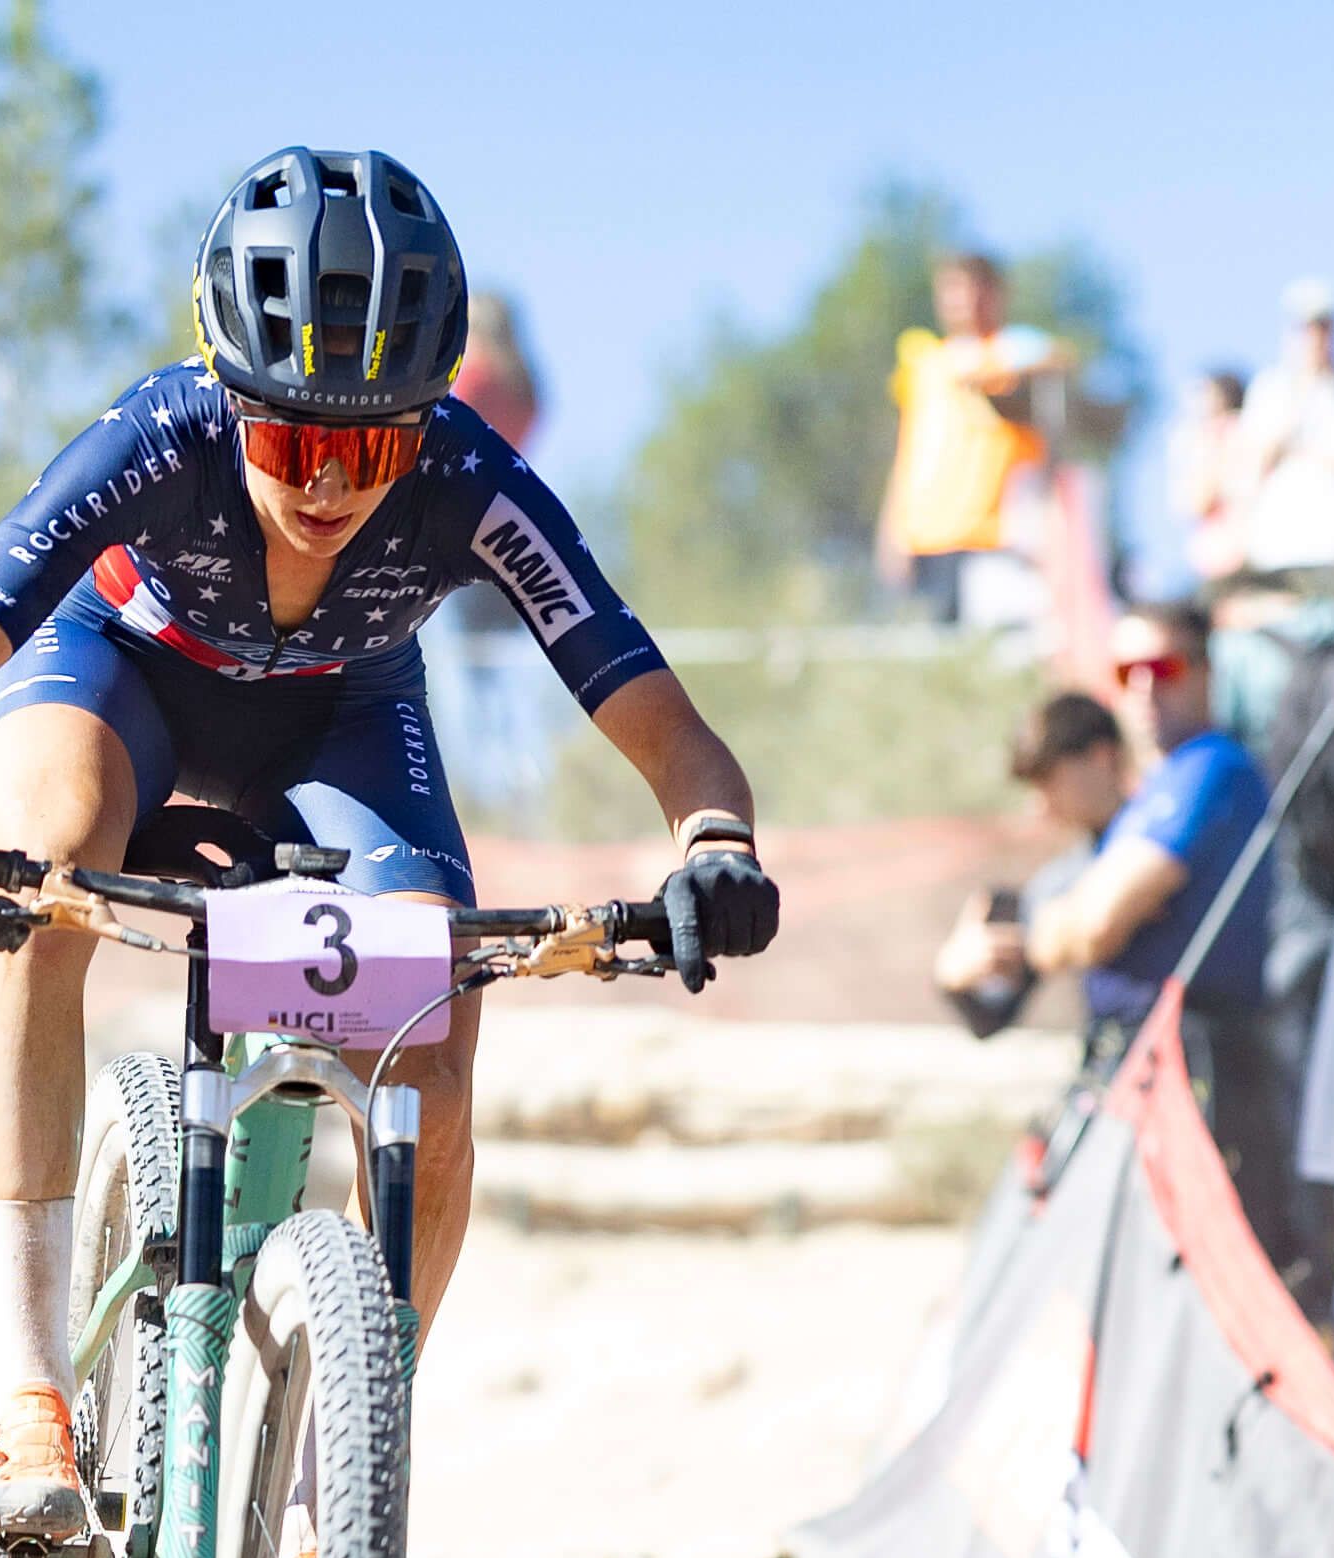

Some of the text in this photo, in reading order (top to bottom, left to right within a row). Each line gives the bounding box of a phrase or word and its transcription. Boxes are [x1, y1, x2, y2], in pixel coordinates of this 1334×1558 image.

[287, 387, 394, 405] ROCKRIDER
[7, 448, 184, 565] ROCKRIDER
[342, 580, 425, 600] SRAM
[480, 519, 580, 626] MAVIC
[303, 903, 358, 997] 3
[280, 1011, 335, 1033] UCI
